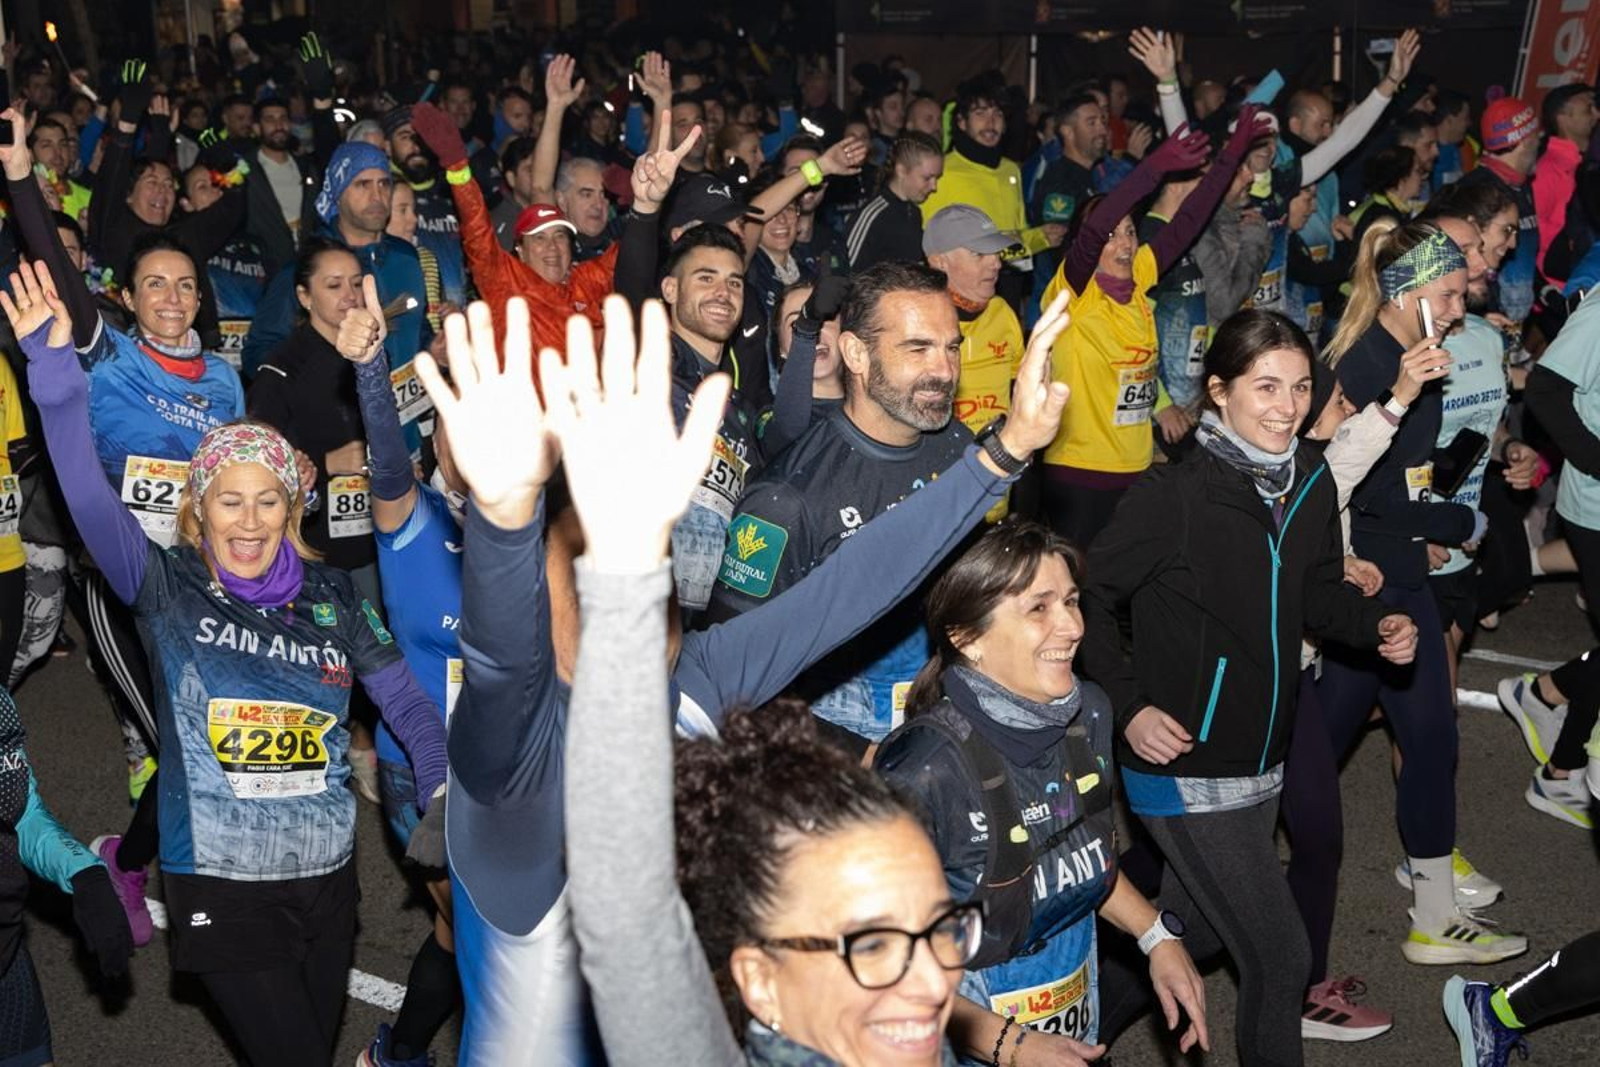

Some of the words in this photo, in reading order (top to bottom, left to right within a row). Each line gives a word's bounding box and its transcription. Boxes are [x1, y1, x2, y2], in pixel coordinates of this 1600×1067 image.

[396, 378, 425, 403] 76
[172, 402, 206, 422] TRAIL
[1442, 393, 1480, 412] ARCANDO
[156, 407, 193, 429] COSTA
[131, 478, 184, 506] 62
[336, 492, 372, 514] 88
[196, 617, 260, 654] SAN
[237, 705, 262, 723] 42
[217, 728, 320, 762] 4296
[1057, 838, 1108, 893] ANT
[1027, 991, 1053, 1014] 42
